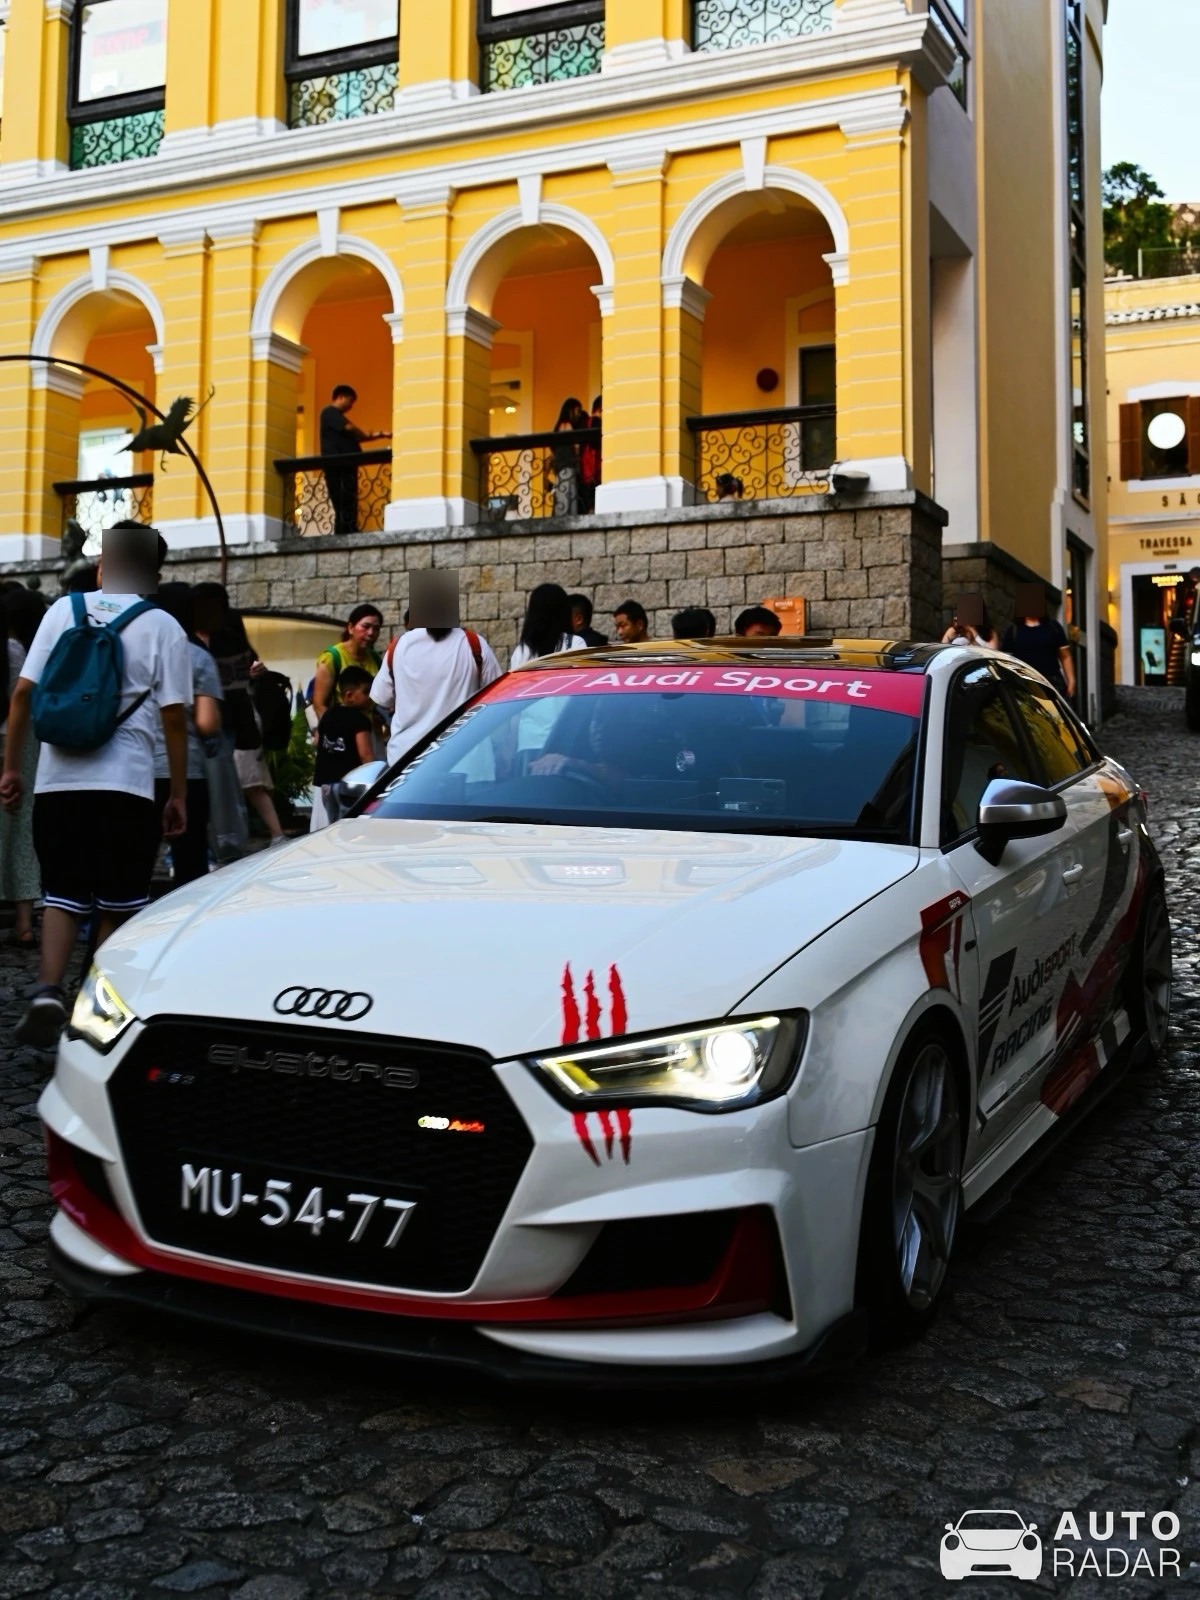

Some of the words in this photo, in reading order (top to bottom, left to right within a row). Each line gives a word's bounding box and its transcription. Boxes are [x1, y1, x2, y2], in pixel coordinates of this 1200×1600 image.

[1139, 536, 1193, 549] TRAVESSA
[583, 670, 701, 690] Audi
[713, 670, 874, 699] Sport
[208, 1043, 421, 1089] quattro
[181, 1163, 418, 1249] MU-54-77
